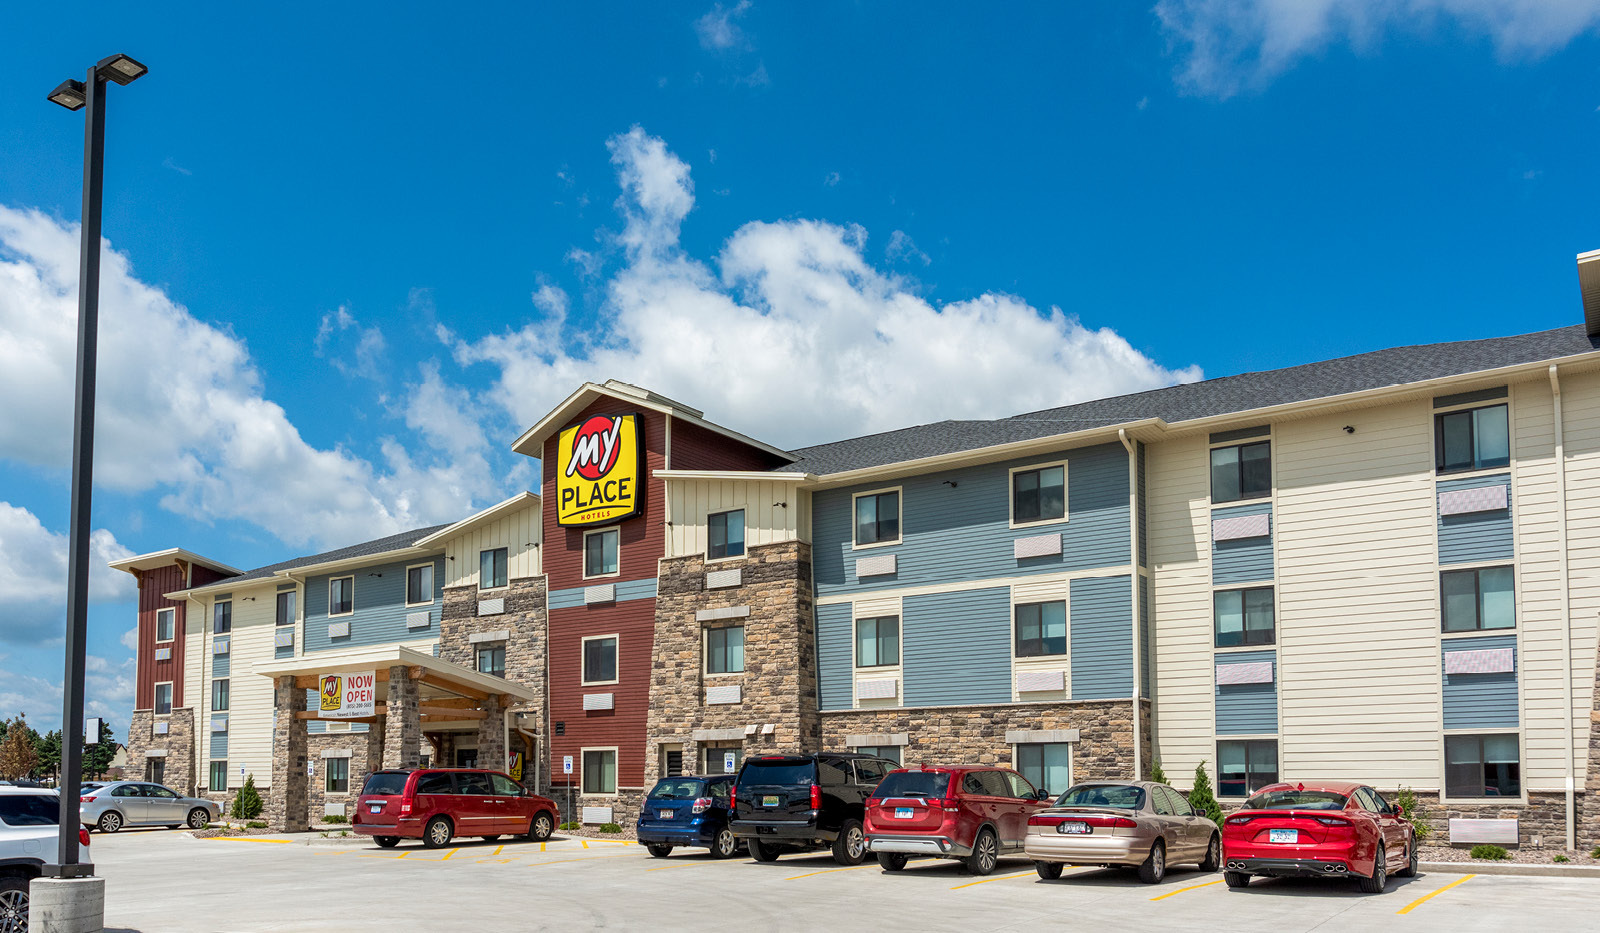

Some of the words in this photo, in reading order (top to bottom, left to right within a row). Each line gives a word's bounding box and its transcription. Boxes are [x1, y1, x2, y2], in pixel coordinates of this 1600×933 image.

[562, 477, 631, 510] PLACE
[581, 511, 610, 520] HOTELS
[348, 675, 372, 689] NOW
[323, 697, 339, 705] PLACE
[347, 690, 372, 702] OPEN
